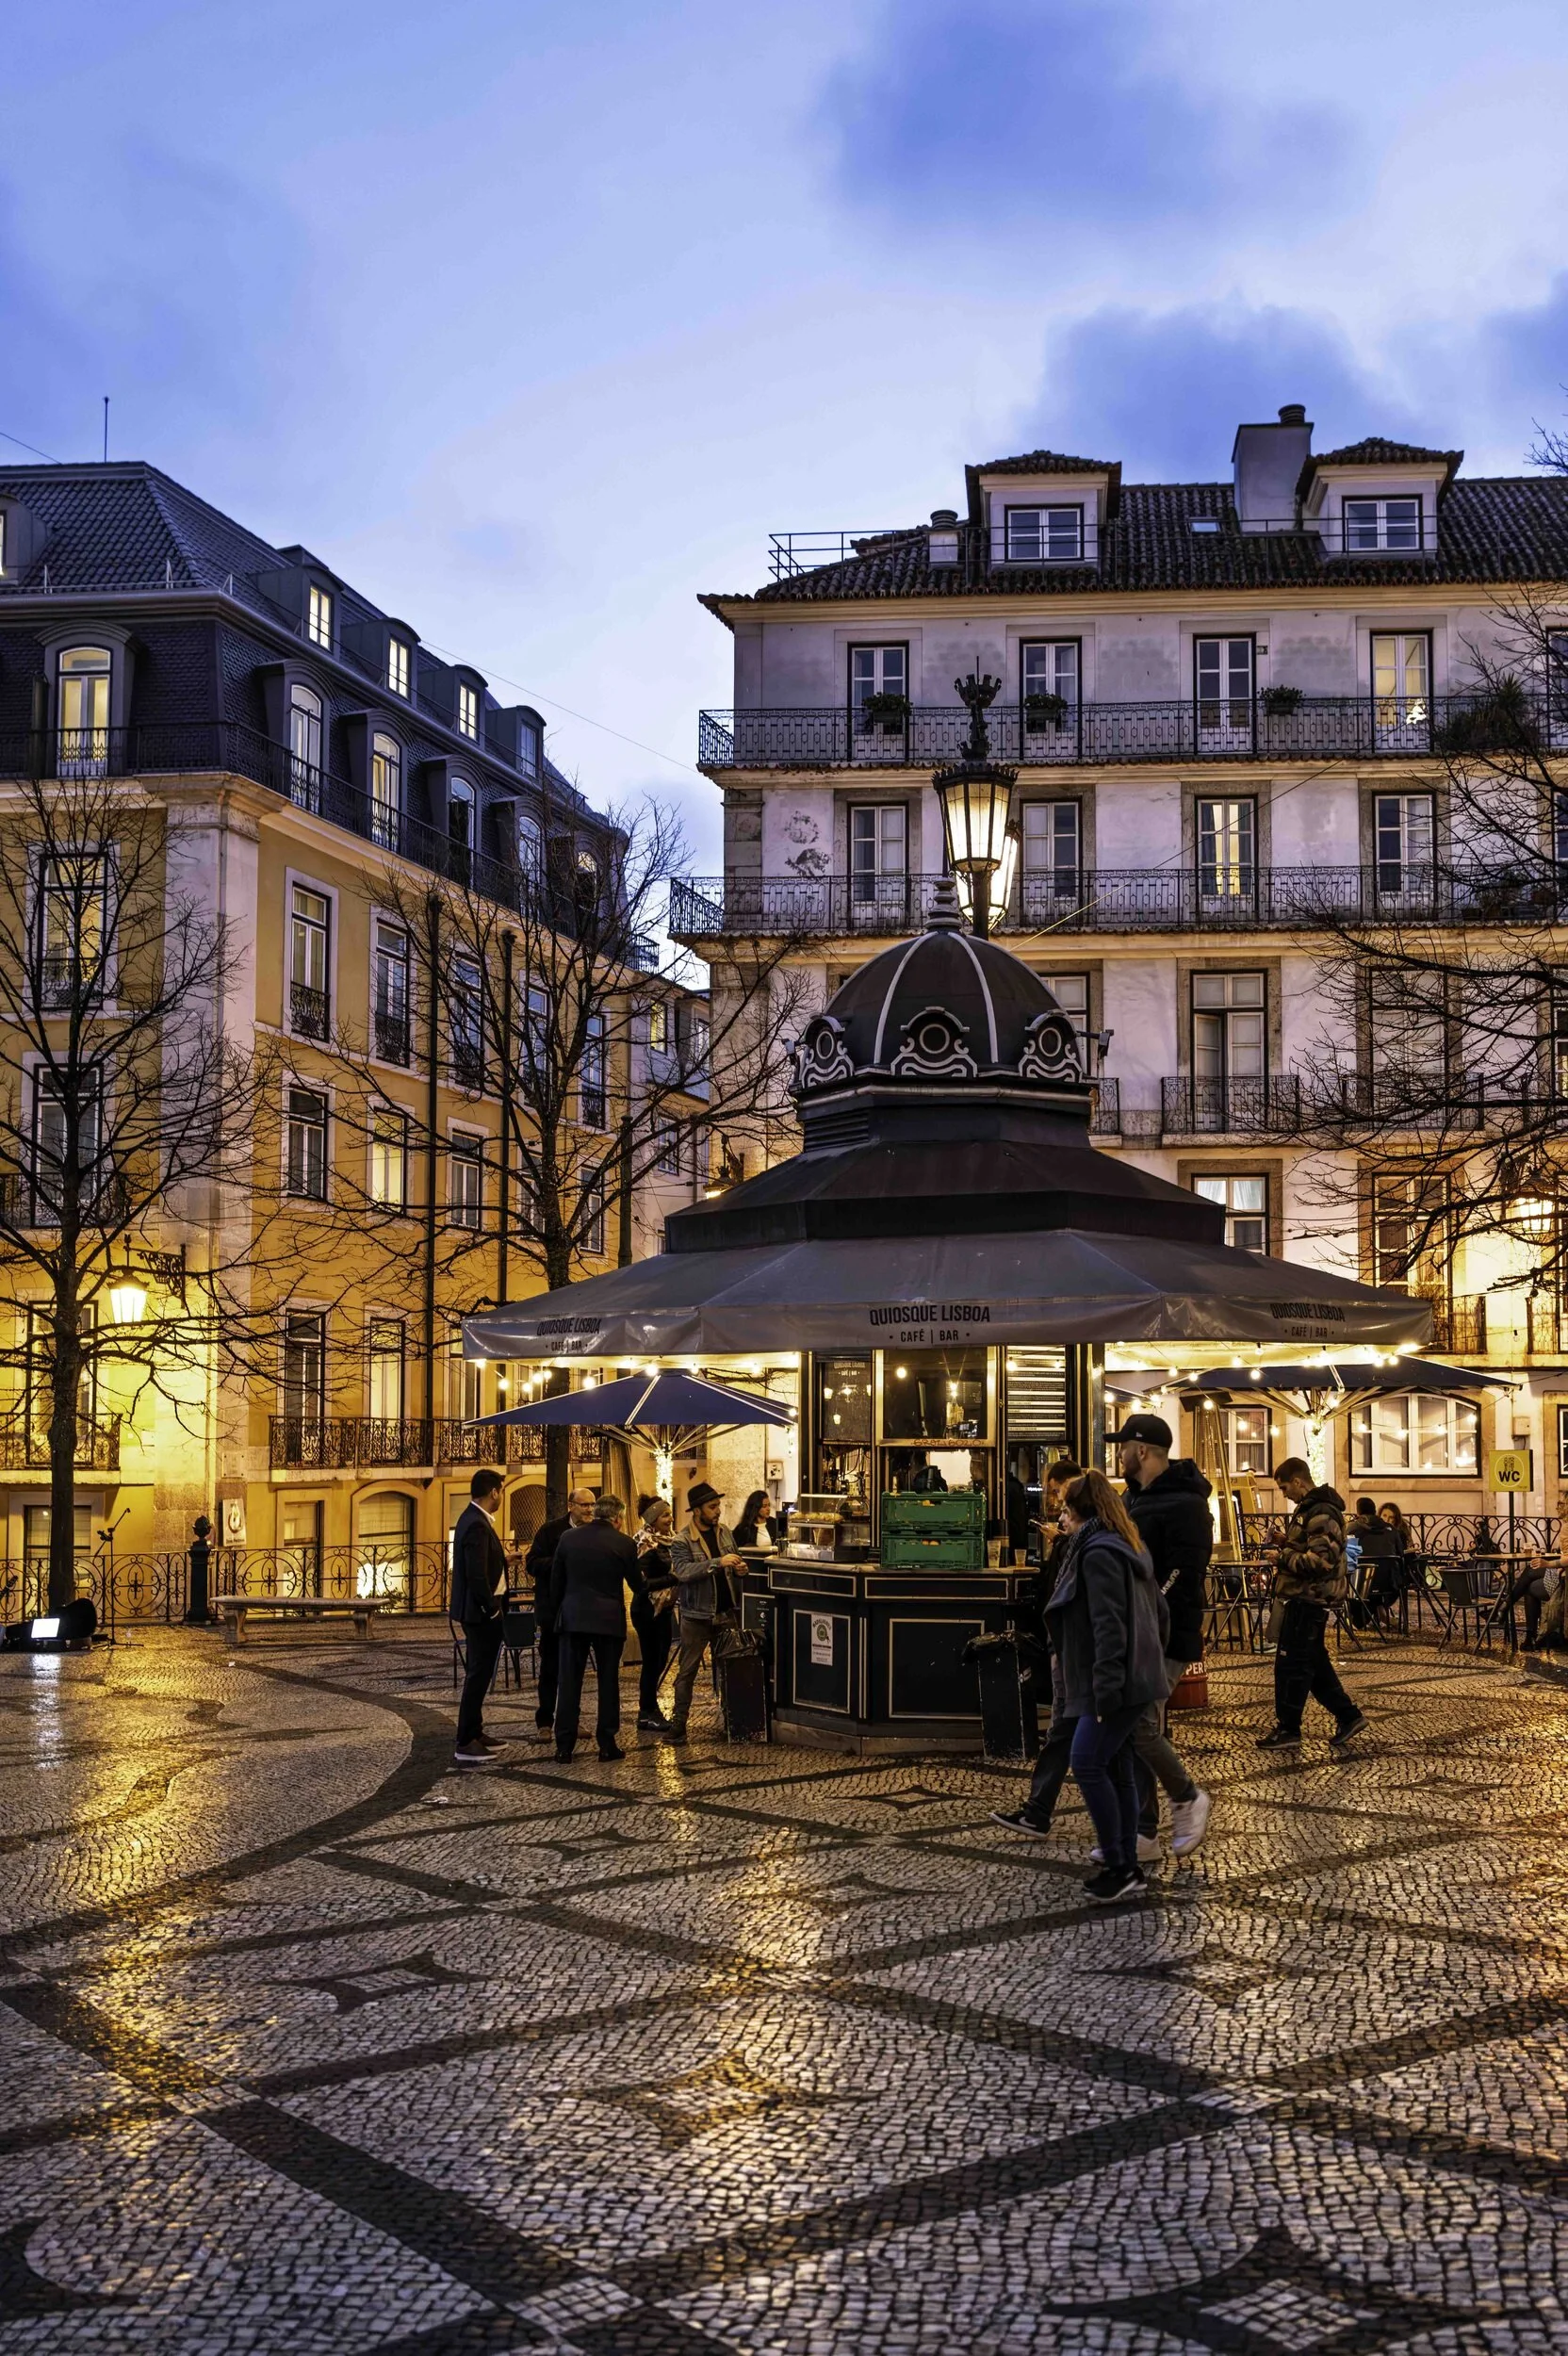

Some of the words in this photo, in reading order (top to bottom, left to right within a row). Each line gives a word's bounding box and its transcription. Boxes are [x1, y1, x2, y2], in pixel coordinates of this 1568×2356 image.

[870, 1305, 938, 1326] QUIOSQUE
[942, 1305, 990, 1322] LISBOA
[1270, 1302, 1314, 1319] QUIOSQUE
[1312, 1303, 1346, 1322] LISBOA
[536, 1317, 575, 1336] QUIOSQUE
[574, 1317, 602, 1334] LISBOA
[1291, 1324, 1307, 1337] CAFÉ
[1315, 1327, 1328, 1338] BAR
[900, 1329, 925, 1342] CAFÉ
[939, 1330, 959, 1341] BAR
[571, 1340, 582, 1351] BAR
[1498, 1470, 1521, 1482] WC
